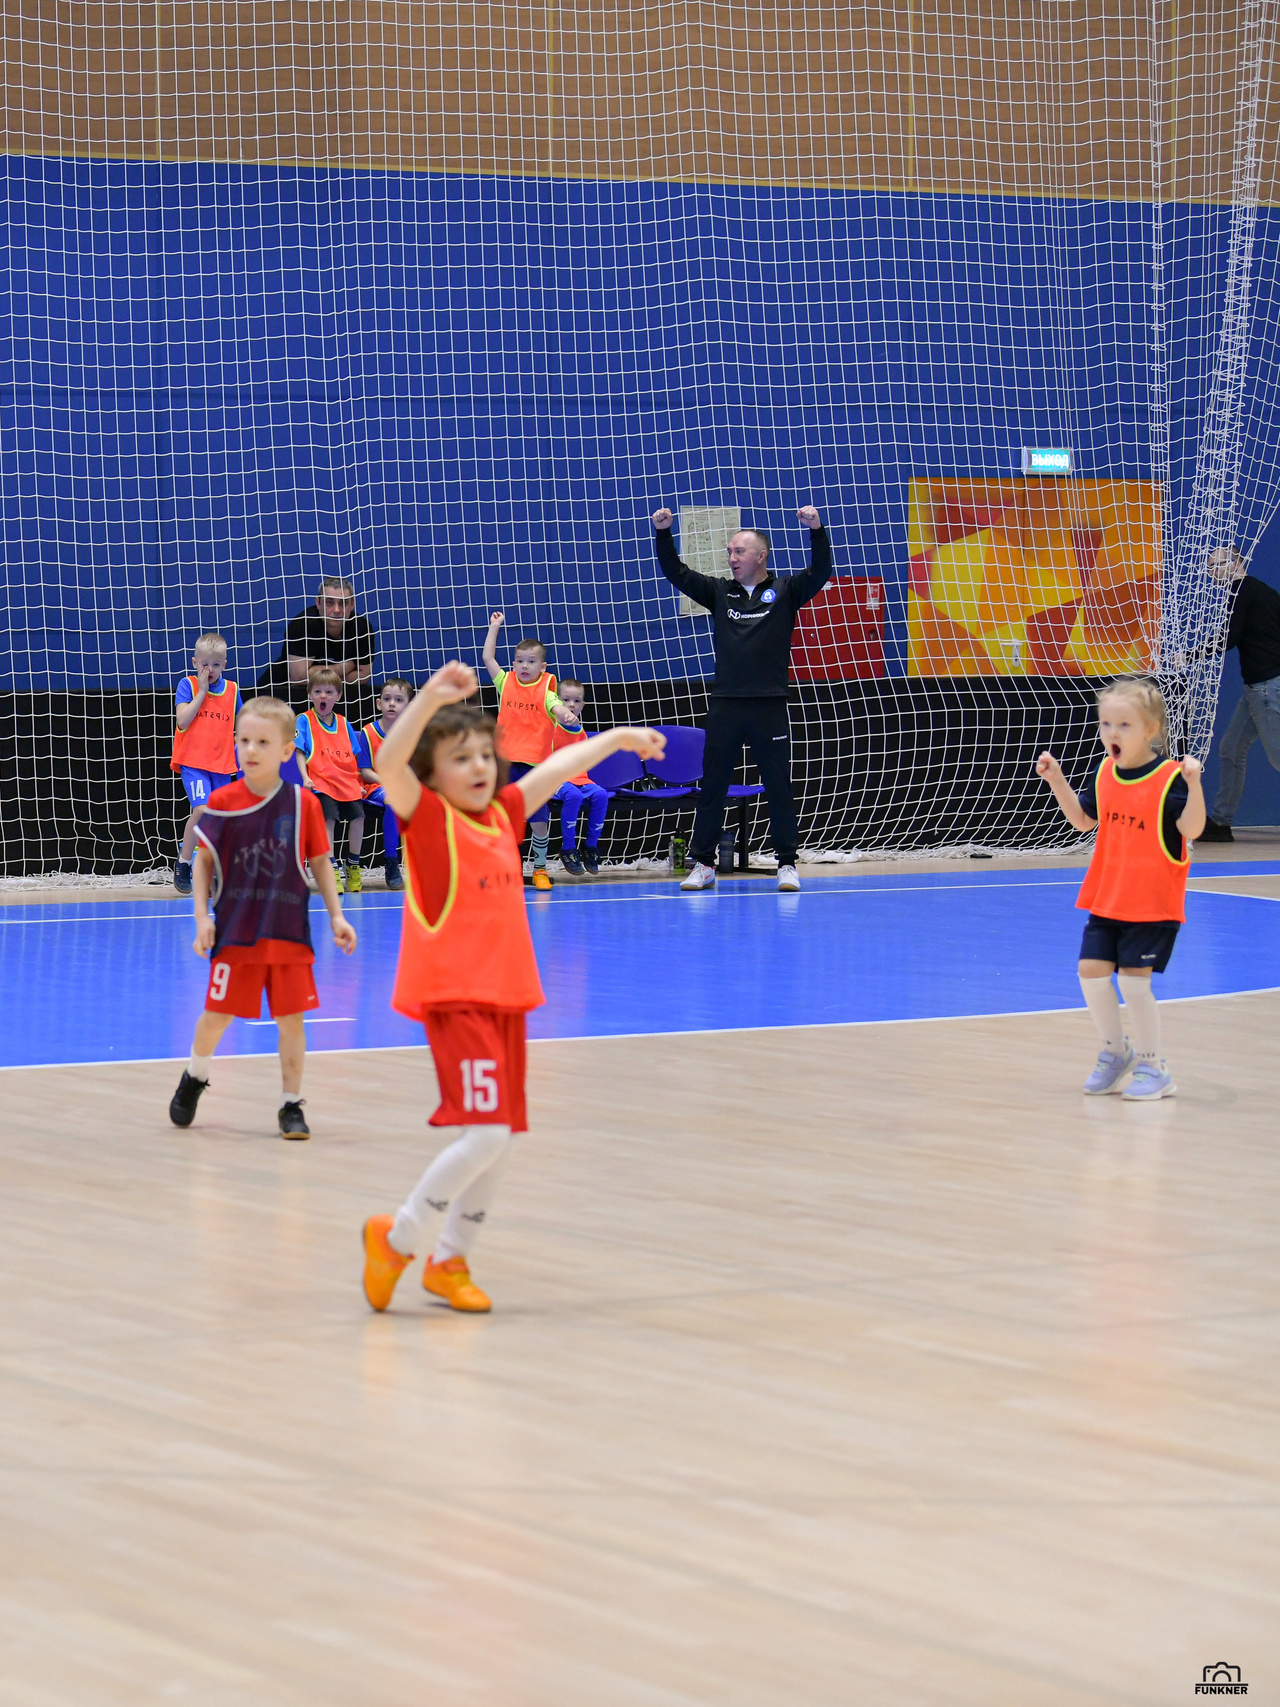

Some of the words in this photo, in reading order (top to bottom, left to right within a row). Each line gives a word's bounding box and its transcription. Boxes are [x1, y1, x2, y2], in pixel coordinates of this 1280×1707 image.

[1031, 453, 1070, 469] ВЫХОД
[189, 779, 206, 801] 14
[1106, 811, 1145, 830] IPSTA
[209, 962, 231, 1001] 9
[460, 1058, 498, 1113] 15
